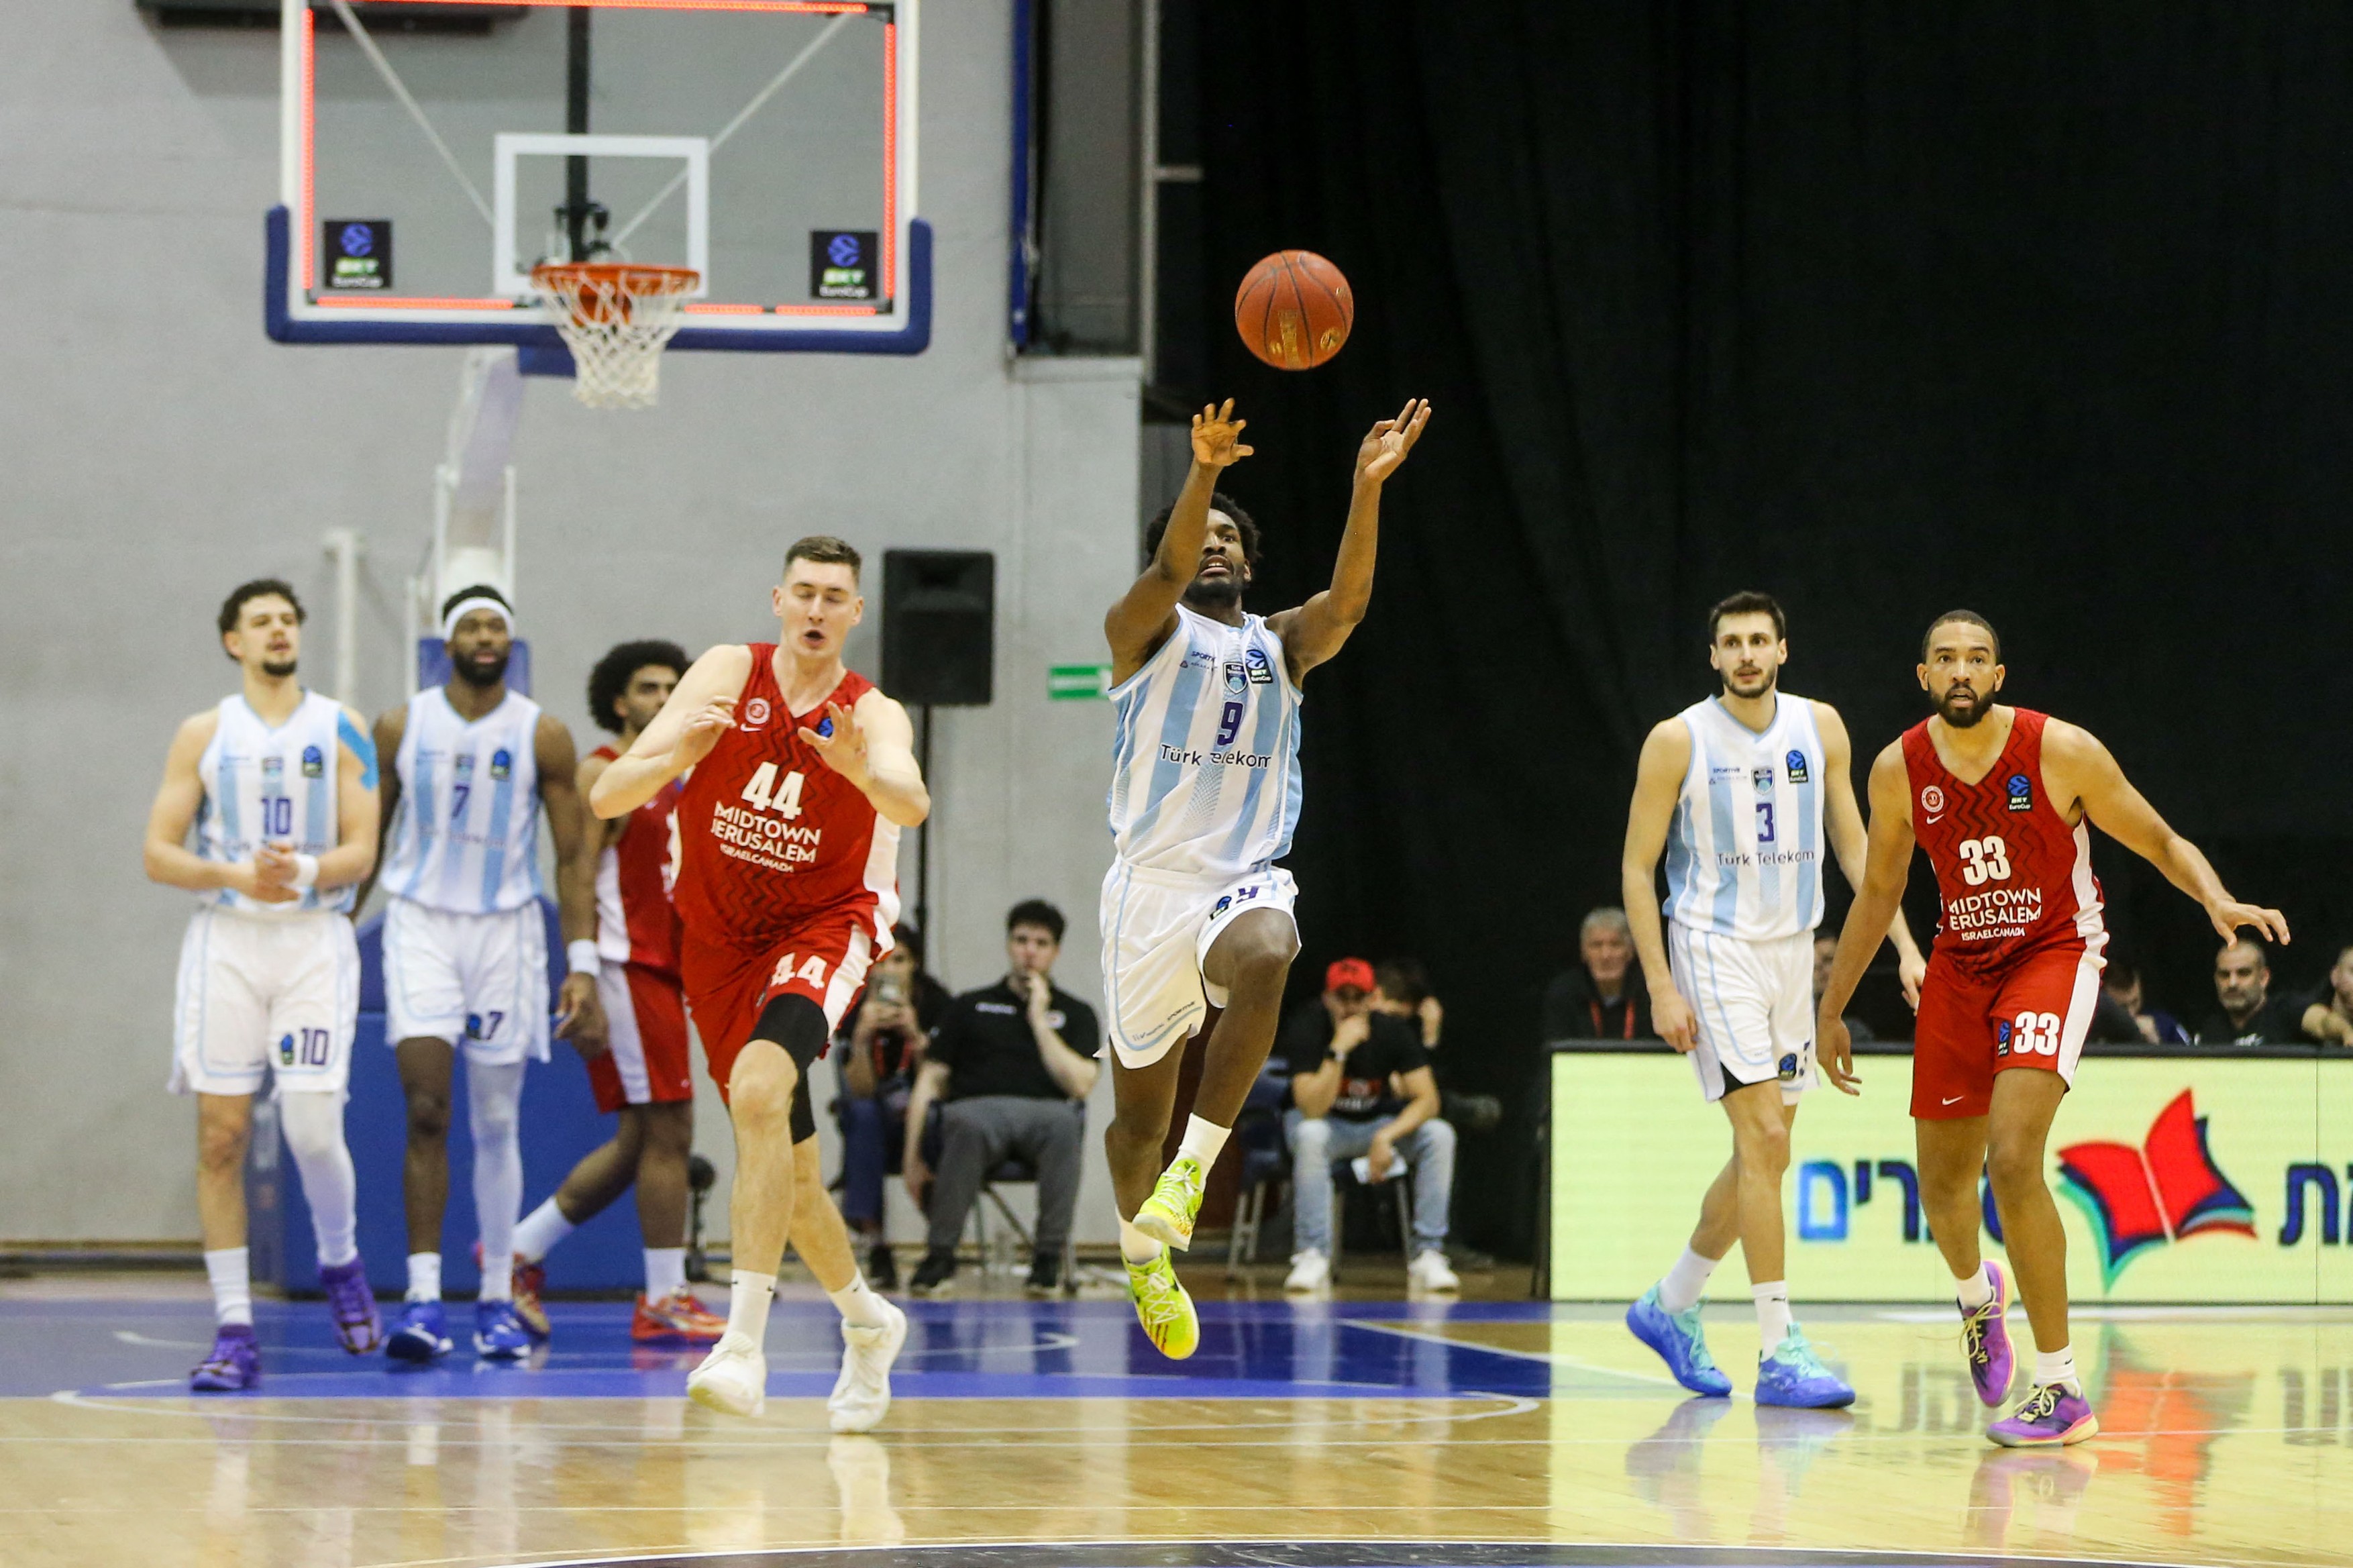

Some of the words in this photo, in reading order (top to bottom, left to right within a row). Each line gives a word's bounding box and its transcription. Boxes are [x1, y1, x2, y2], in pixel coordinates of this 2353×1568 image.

[1217, 701, 1243, 746] 9
[1161, 744, 1202, 766] Türk
[452, 785, 470, 819] 7
[741, 761, 804, 820] 44
[261, 797, 291, 835] 10
[714, 800, 822, 845] MIDTOWN
[1756, 802, 1775, 843] 3
[1757, 849, 1814, 865] Telekom
[1959, 835, 2011, 886] 33
[1950, 904, 2042, 931] ERUSALEM
[770, 952, 827, 989] 44
[486, 1011, 503, 1041] 7
[2014, 1010, 2060, 1056] 33
[301, 1028, 329, 1065] 10
